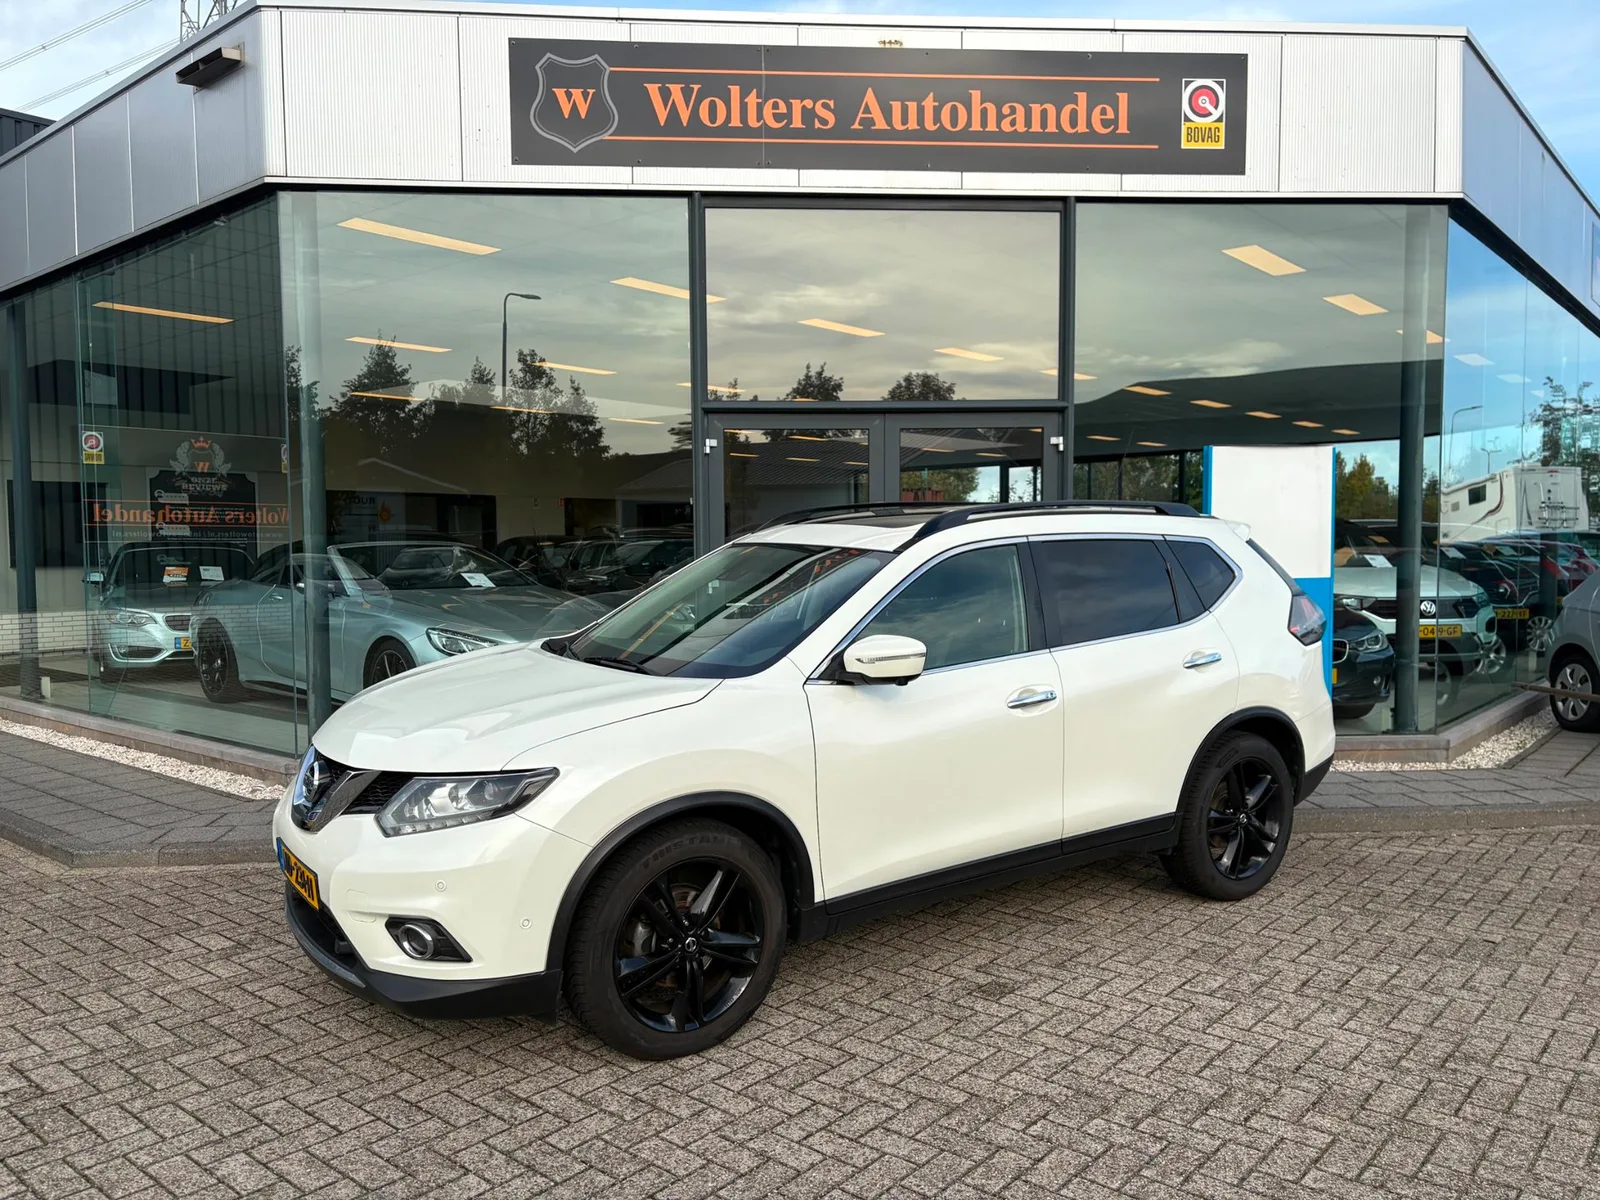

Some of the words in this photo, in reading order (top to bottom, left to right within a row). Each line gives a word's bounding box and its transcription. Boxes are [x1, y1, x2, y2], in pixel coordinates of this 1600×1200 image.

[552, 87, 596, 119] W
[643, 83, 836, 130] Wolters
[850, 87, 1130, 135] Autohandel
[1185, 126, 1221, 144] BOVAG
[181, 483, 229, 491] REVIEWS
[1419, 626, 1458, 637] -049-GF
